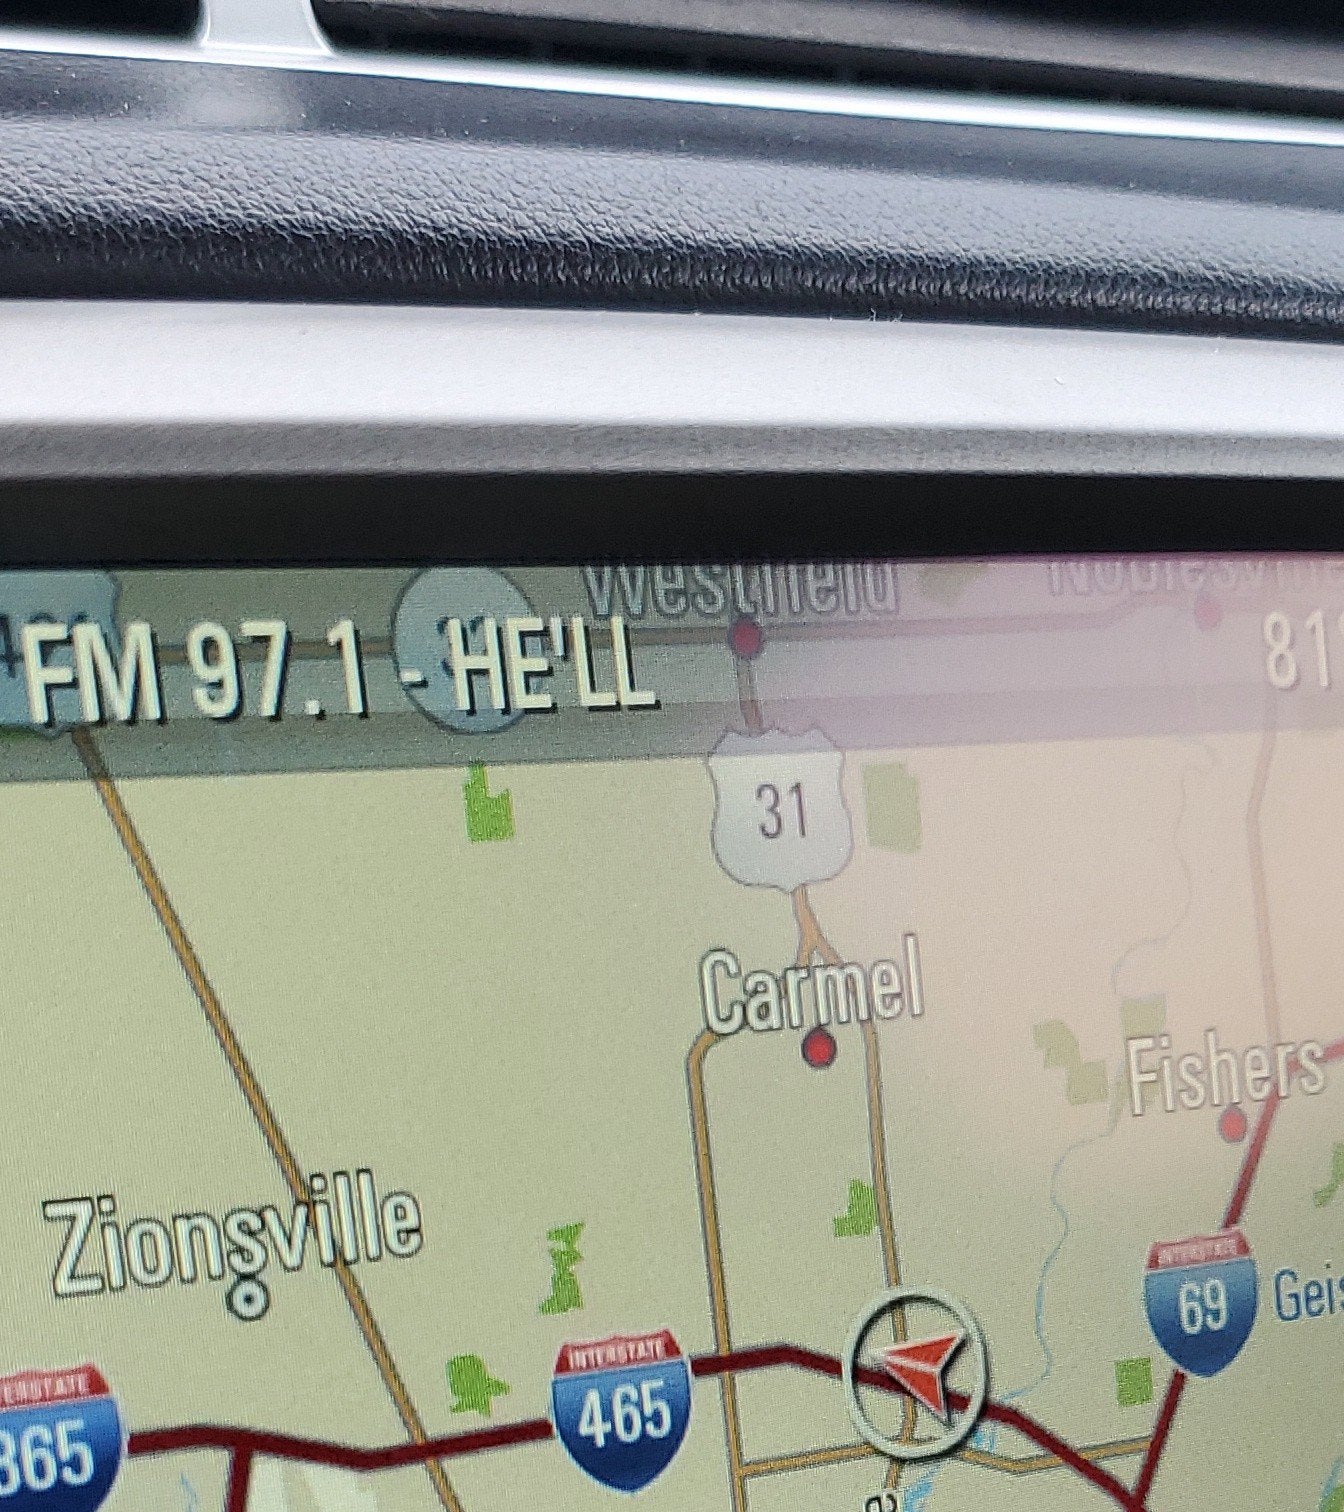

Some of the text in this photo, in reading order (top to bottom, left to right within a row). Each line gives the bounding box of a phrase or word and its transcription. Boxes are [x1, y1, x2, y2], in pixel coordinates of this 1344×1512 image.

[21, 620, 162, 724] FM
[187, 618, 367, 720] 97.1
[447, 614, 661, 714] HE'LL
[756, 782, 808, 840] 31
[698, 933, 925, 1036] Carmel
[1124, 1027, 1329, 1118] Fishers
[42, 1168, 425, 1301] Zionsville
[1178, 1278, 1229, 1335] 69
[577, 1378, 673, 1449] 465
